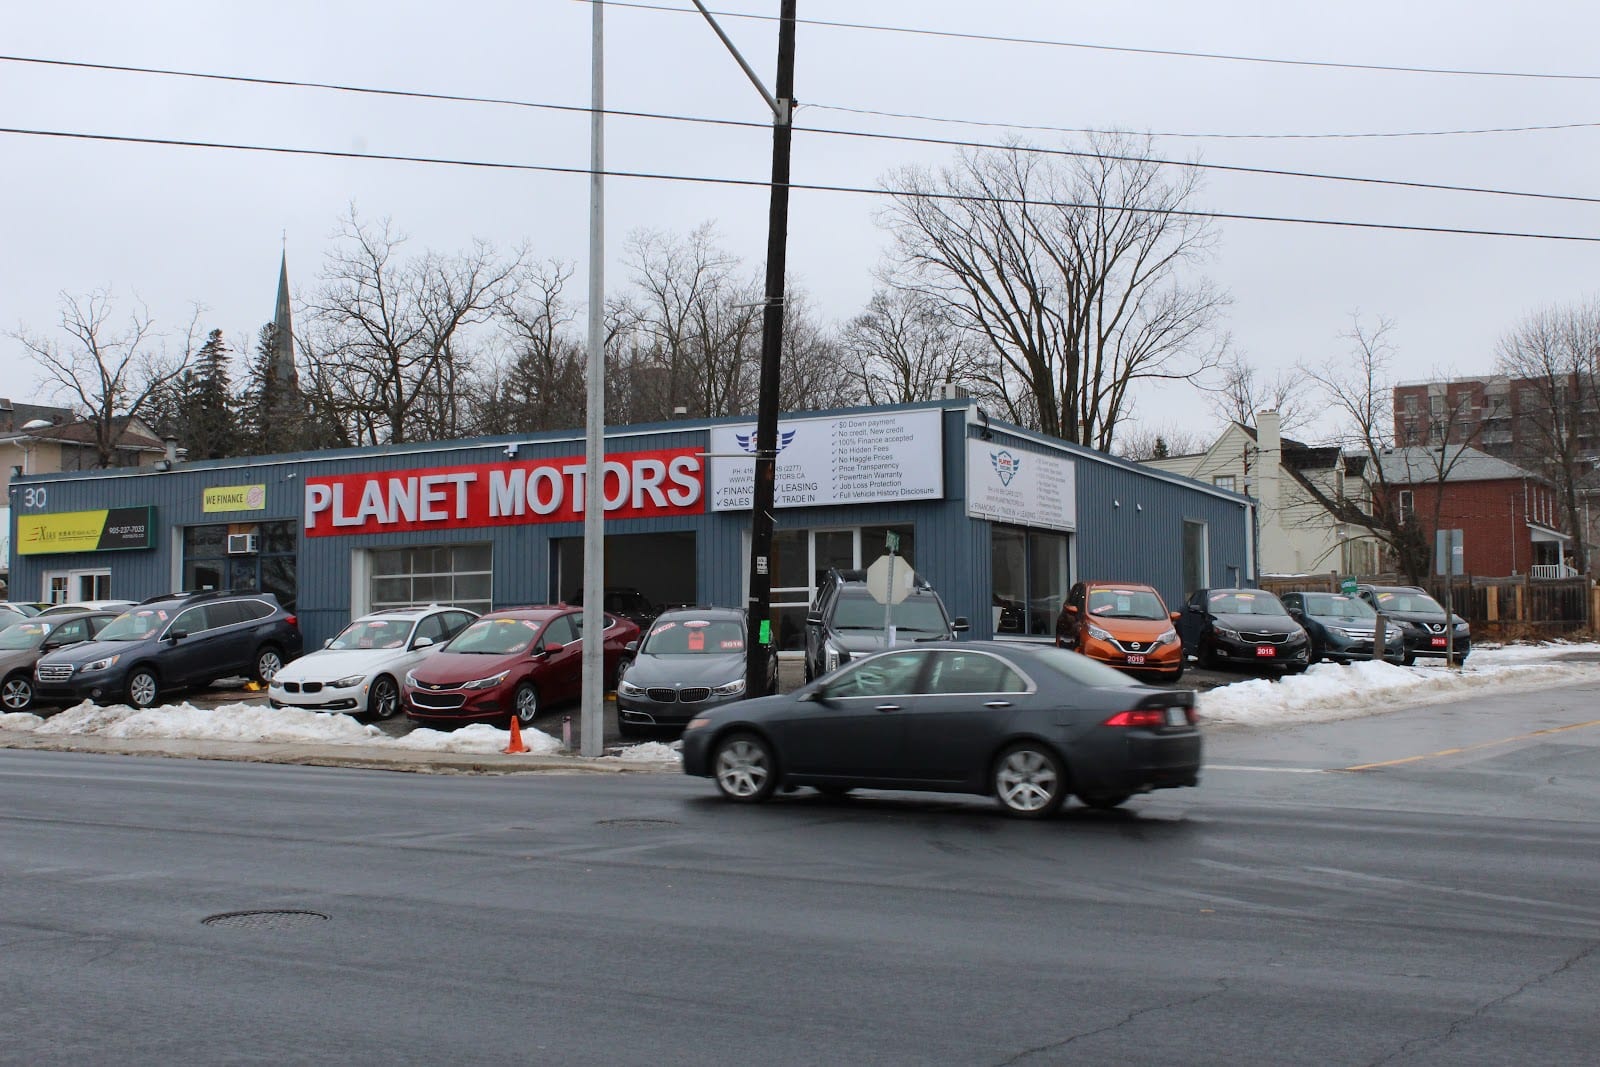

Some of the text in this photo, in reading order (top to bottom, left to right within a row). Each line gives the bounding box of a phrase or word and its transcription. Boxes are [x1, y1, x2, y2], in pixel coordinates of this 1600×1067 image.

[848, 420, 867, 428] Down
[867, 418, 896, 427] payment
[885, 426, 904, 434] credit
[857, 437, 883, 445] Finance
[884, 434, 914, 443] accepted
[849, 446, 872, 454] Hidden
[849, 455, 872, 464] Haggle
[873, 453, 893, 461] Prices
[783, 464, 802, 472] (2277)
[856, 462, 900, 472] Transparency
[839, 471, 903, 481] Powertrain Warranty
[723, 482, 818, 496] FINANC LEASING
[869, 480, 902, 488] Protection
[304, 455, 701, 529] PLANET MOTORS
[839, 487, 935, 499] Full Vehicle History Disclosure
[24, 487, 47, 509] 30
[205, 493, 244, 505] WE FINANCE
[723, 494, 816, 507] SALES TRADE IN
[108, 525, 145, 535] 905-237-7033
[1127, 655, 1144, 663] 2019
